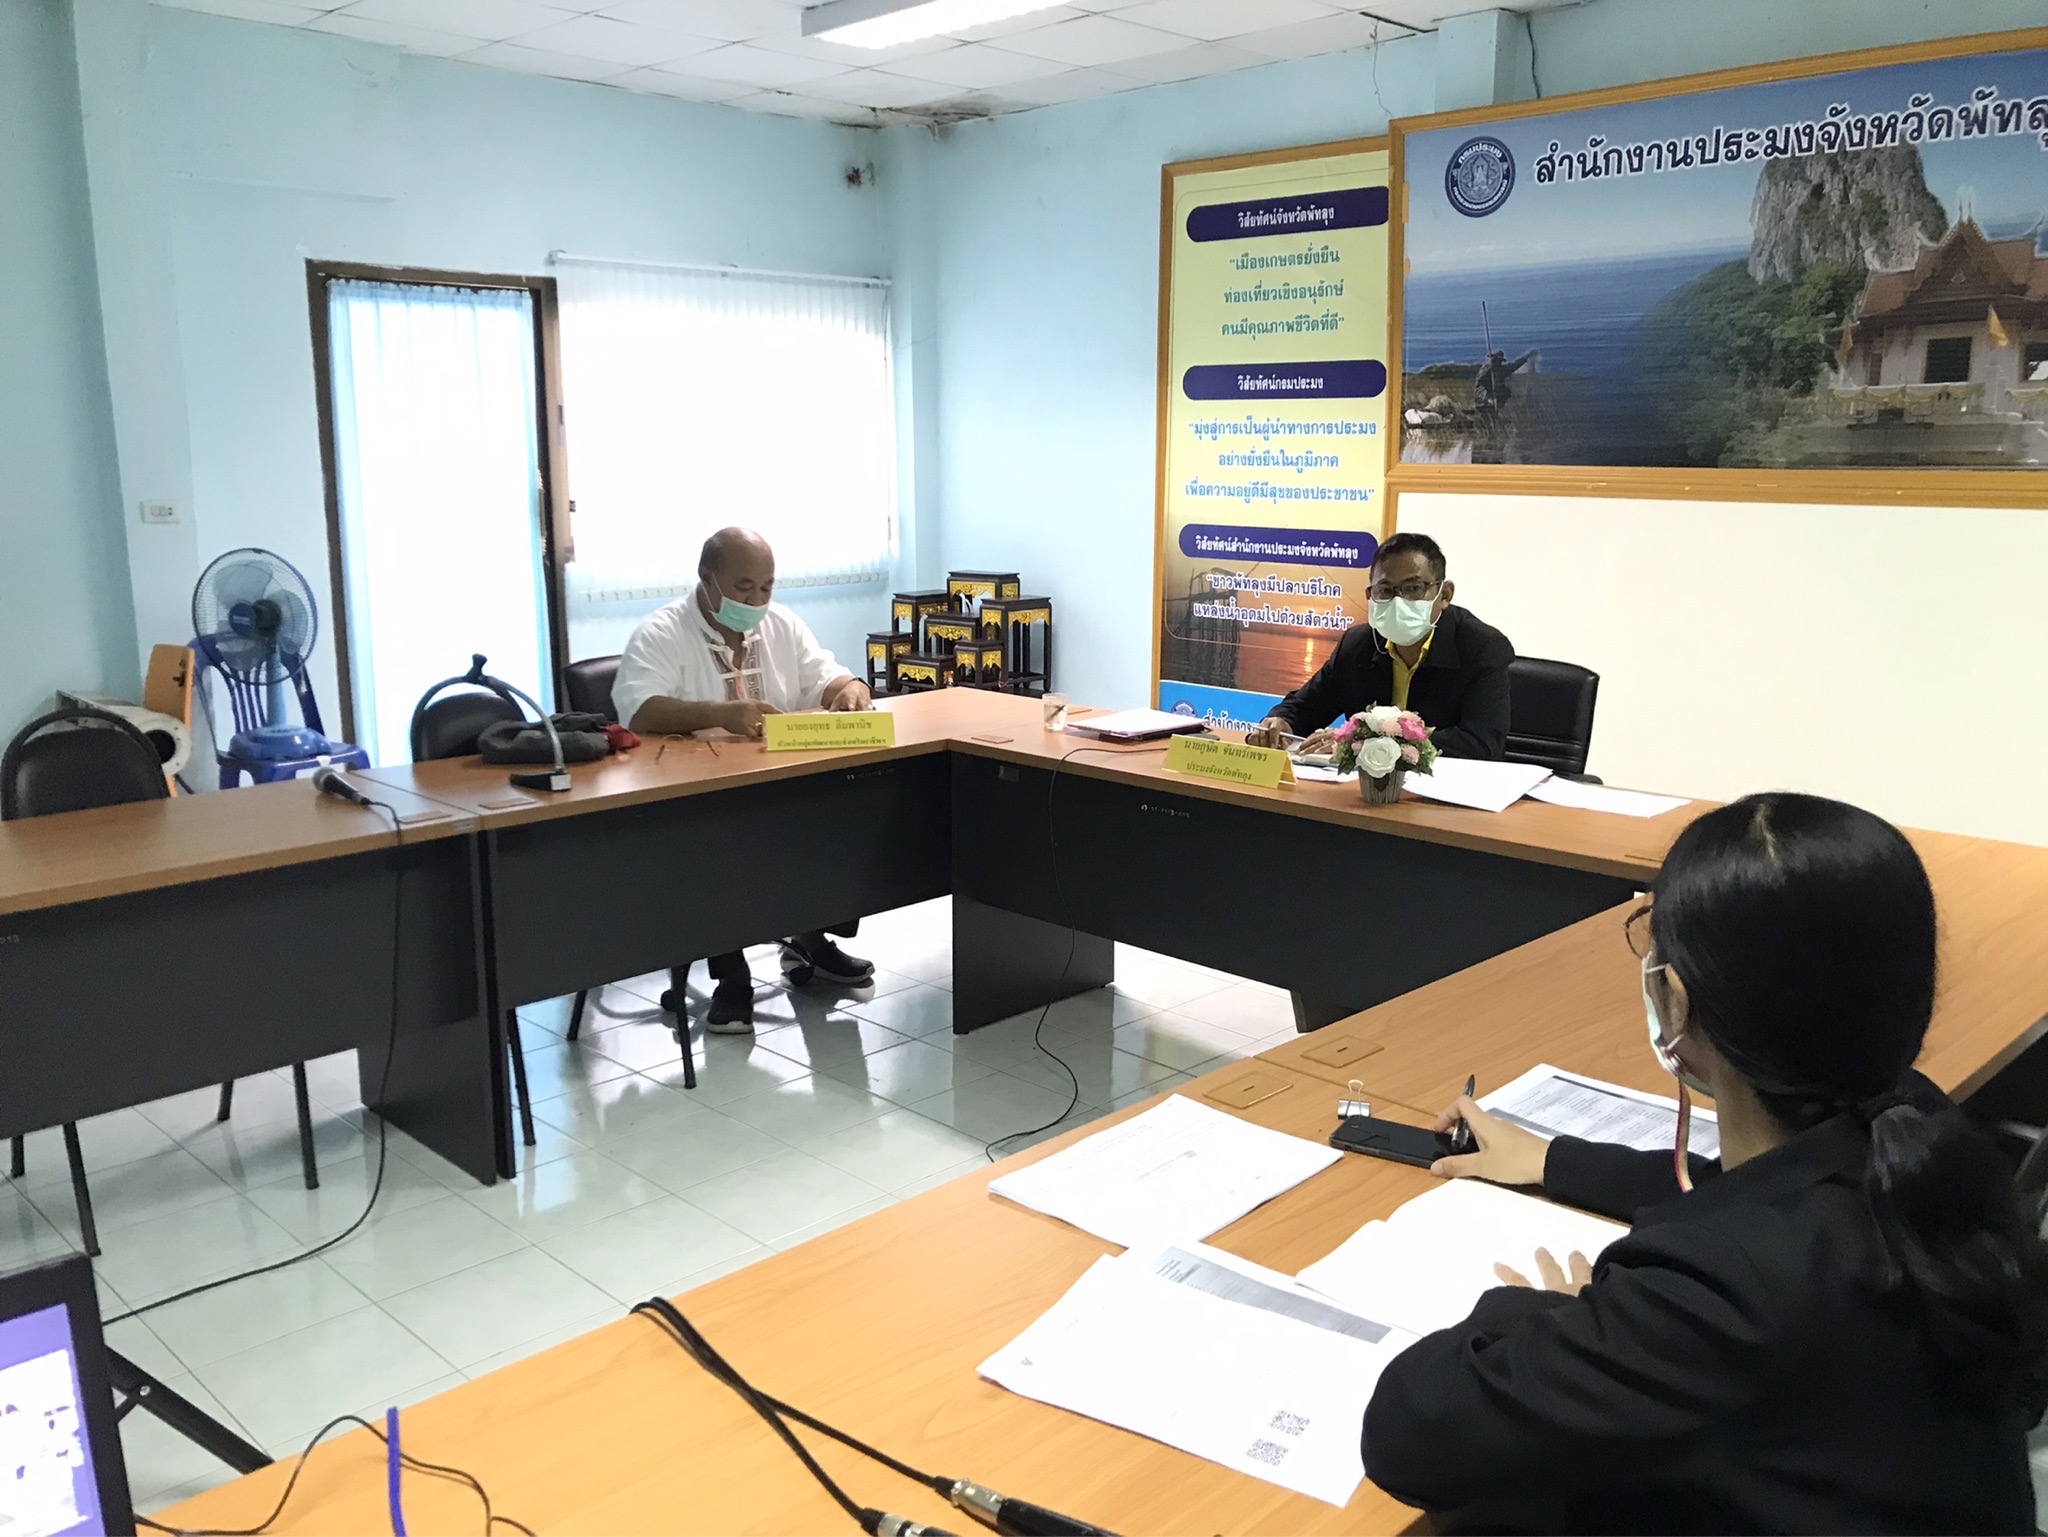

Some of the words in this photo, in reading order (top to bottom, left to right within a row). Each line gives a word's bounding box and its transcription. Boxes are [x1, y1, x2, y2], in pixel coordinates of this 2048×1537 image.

[1535, 87, 2048, 184] สำนักงานประมงจังหวัดพัทลุ
[1237, 204, 1334, 228] วิสัยทัศน์จังหวัดพัทลุง
[1223, 279, 1344, 304] ท่องเที่ยวเชิงอนุรักษ์
[1237, 374, 1324, 391] วิสัยทัศน์กรมประมง
[1218, 446, 1339, 474] อย่างยั่งยืนในภูมิภาค
[1195, 535, 1359, 566] วิสัยทัศน์สำนักงานประมงจังหวัดพัทลุง
